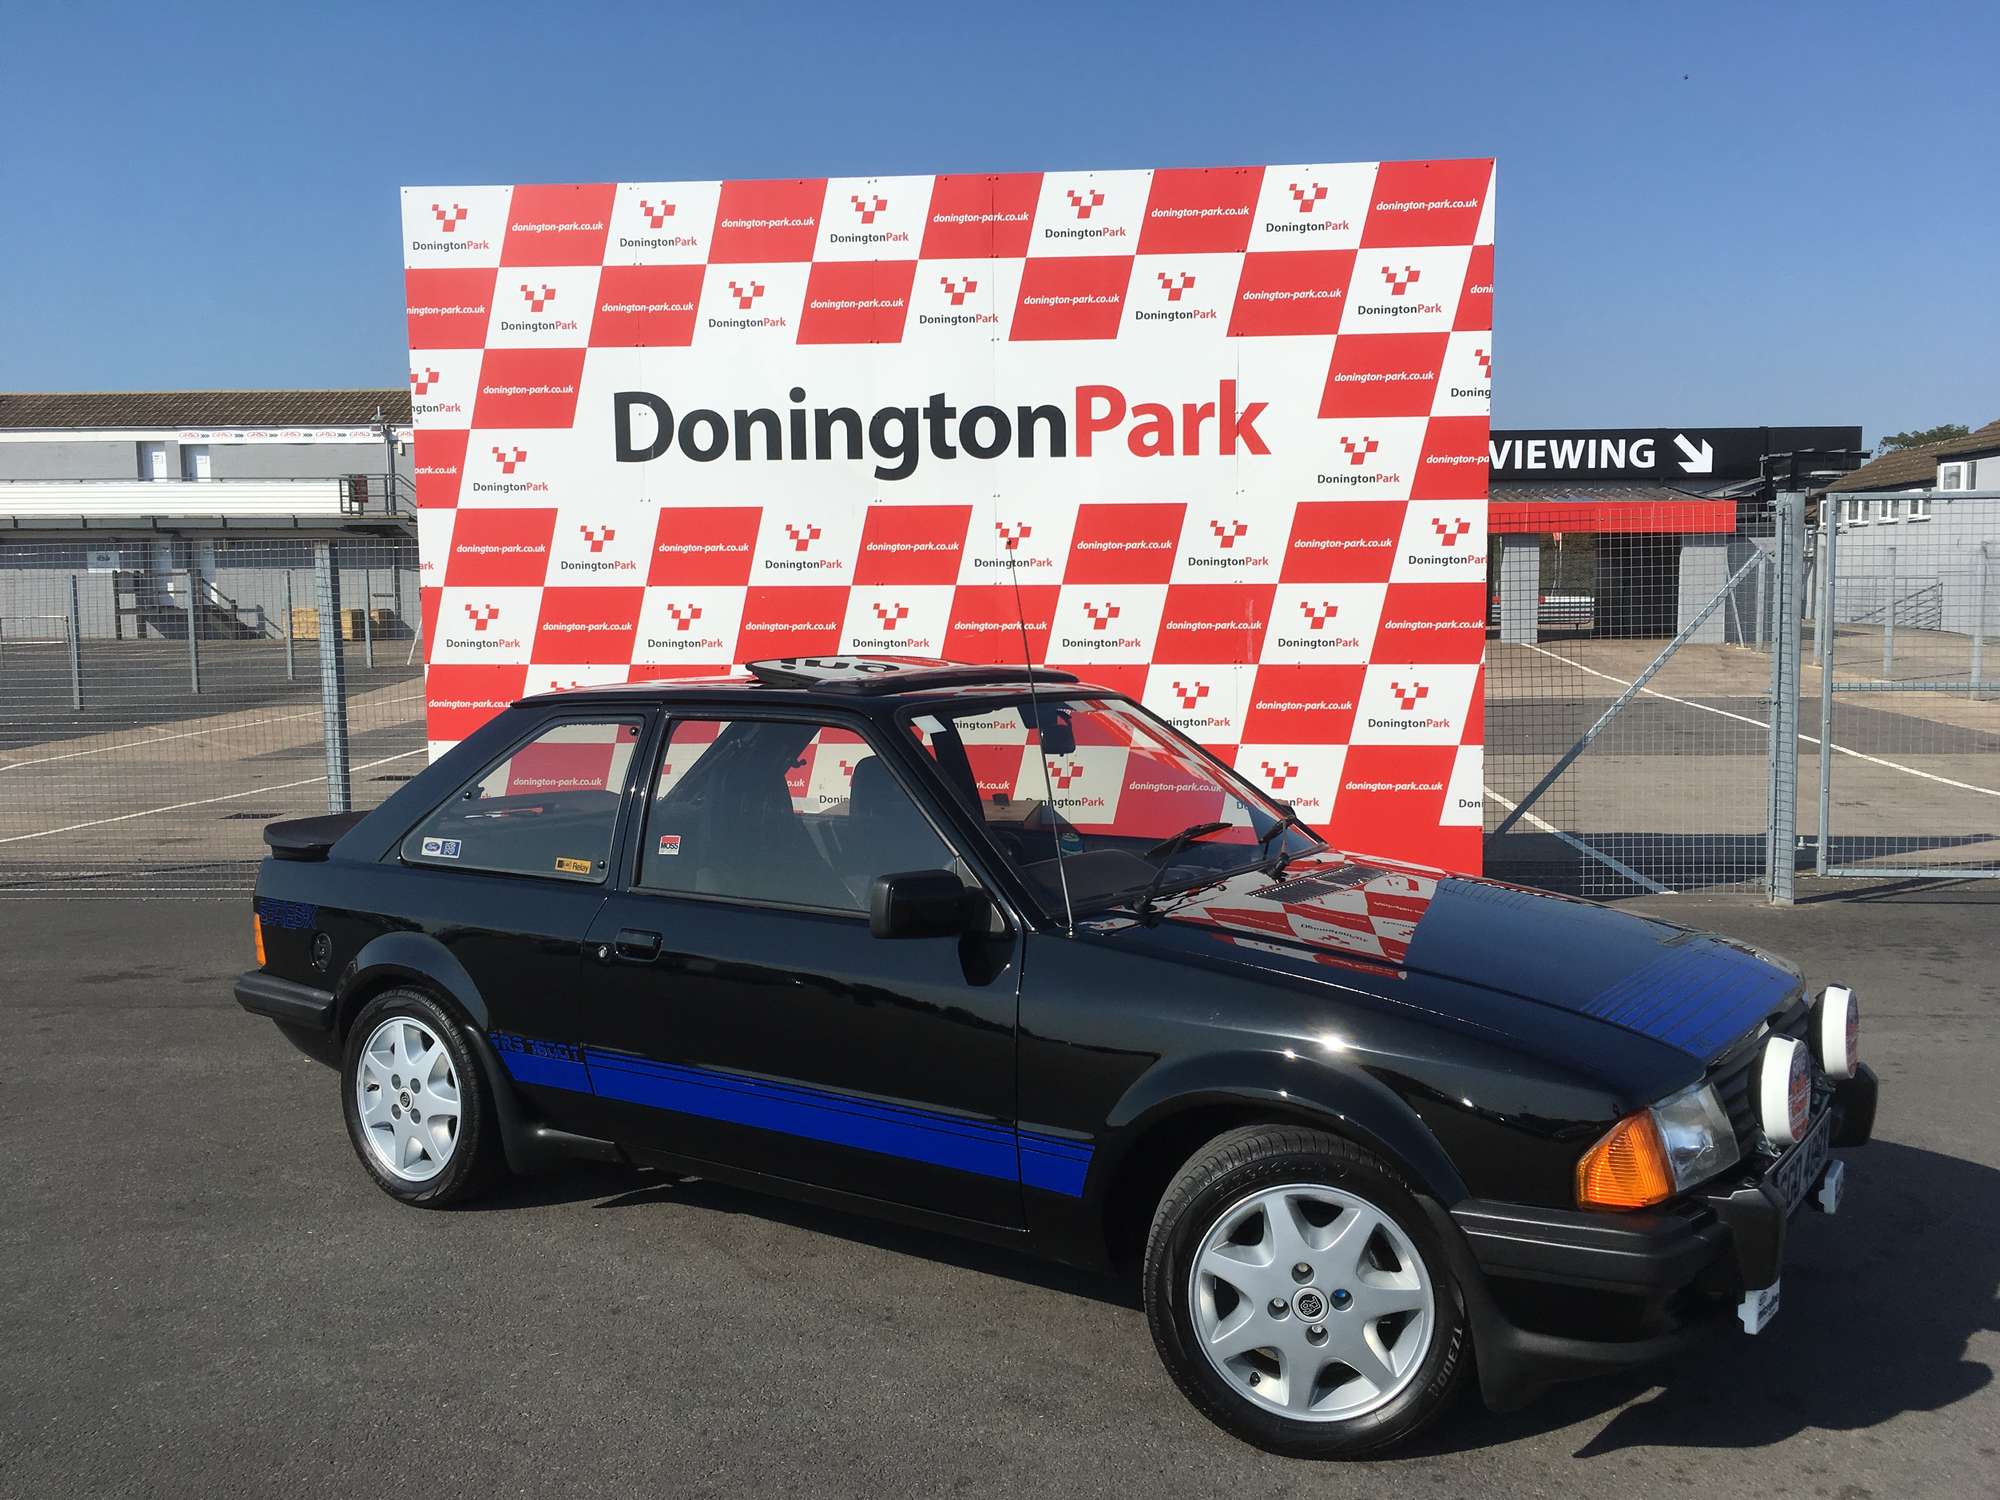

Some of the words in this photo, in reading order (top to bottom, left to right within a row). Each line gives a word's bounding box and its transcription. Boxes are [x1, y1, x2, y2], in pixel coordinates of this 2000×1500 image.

[1376, 199, 1477, 211] donington-park.co.uk
[1152, 206, 1249, 218] donington-park.co.uk
[722, 217, 814, 229] donington-park.co.uk
[934, 212, 1028, 224] donington-park.co.uk
[512, 222, 603, 233] donington-park.co.uk
[1266, 221, 1348, 233] DoningtonPark
[831, 232, 908, 244] DoningtonPark
[1046, 227, 1125, 239] DoningtonPark
[413, 241, 488, 252] DoningtonPark
[620, 237, 697, 248] DoningtonPark
[1024, 294, 1119, 306] donington-park.co.uk
[1243, 289, 1341, 301] donington-park.co.uk
[602, 302, 693, 313] donington-park.co.uk
[811, 298, 903, 310] donington-park.co.uk
[1136, 310, 1216, 321] DoningtonPark
[1358, 304, 1441, 316] DoningtonPark
[709, 318, 785, 329] DoningtonPark
[920, 314, 998, 325] DoningtonPark
[501, 321, 577, 332] DoningtonPark
[1335, 372, 1433, 383] donington-park.co.uk
[483, 385, 573, 396] donington-park.co.uk
[614, 379, 1271, 481] DoningtonPark
[1489, 439, 1655, 469] VIEWING
[1318, 473, 1399, 485] DoningtonPark
[473, 482, 548, 493] DoningtonPark
[457, 544, 545, 554] donington-park.co.uk
[659, 544, 748, 553] donington-park.co.uk
[867, 542, 959, 552] donington-park.co.uk
[1077, 540, 1172, 551] donington-park.co.uk
[1294, 539, 1392, 549] donington-park.co.uk
[561, 561, 636, 572] DoningtonPark
[766, 560, 842, 571] DoningtonPark
[975, 558, 1052, 570] DoningtonPark
[1189, 557, 1268, 568] DoningtonPark
[543, 622, 632, 632] donington-park.co.uk
[746, 622, 837, 632] donington-park.co.uk
[955, 621, 1047, 631] donington-park.co.uk
[1167, 621, 1262, 631] donington-park.co.uk
[1385, 620, 1484, 630] donington-park.co.uk
[447, 639, 520, 649] DoningtonPark
[648, 639, 723, 649] DoningtonPark
[853, 639, 929, 649] DoningtonPark
[1063, 639, 1140, 649] DoningtonPark
[1278, 638, 1359, 649] DoningtonPark
[1256, 701, 1352, 711] donington-park.co.uk
[1368, 719, 1449, 730] DoningtonPark
[514, 778, 601, 787] donington-park.co.uk
[1346, 782, 1443, 792] donington-park.co.uk
